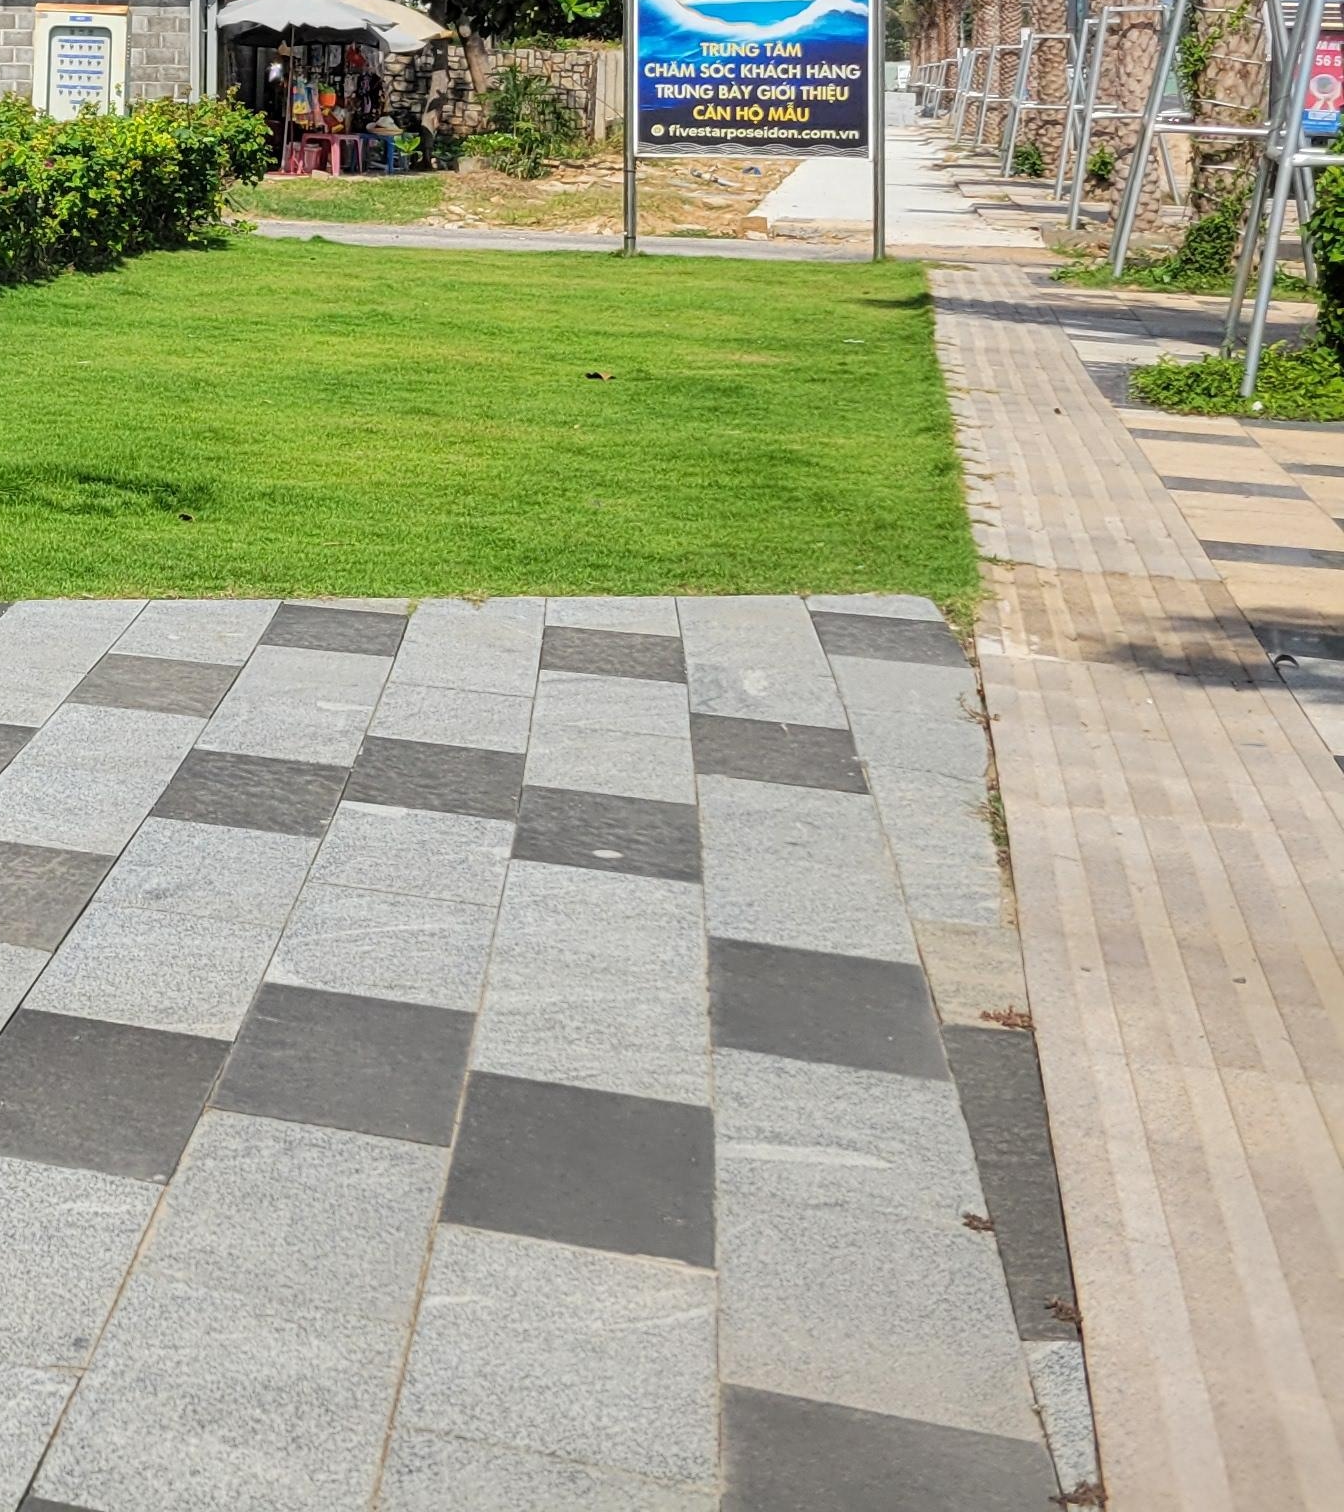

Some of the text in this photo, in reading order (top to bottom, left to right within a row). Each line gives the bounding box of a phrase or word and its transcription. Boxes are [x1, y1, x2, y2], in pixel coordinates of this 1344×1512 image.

[699, 40, 802, 57] TRUNG TÂM
[644, 59, 861, 79] CHĂM SÓC KHÁCH HÀNG
[718, 81, 753, 100] BÀY
[756, 81, 795, 100] GIỚI
[799, 84, 849, 103] THIỆU
[692, 101, 810, 124] CĂN HỘ MẪU
[668, 123, 860, 140] fivestarposeidon.com.vn
